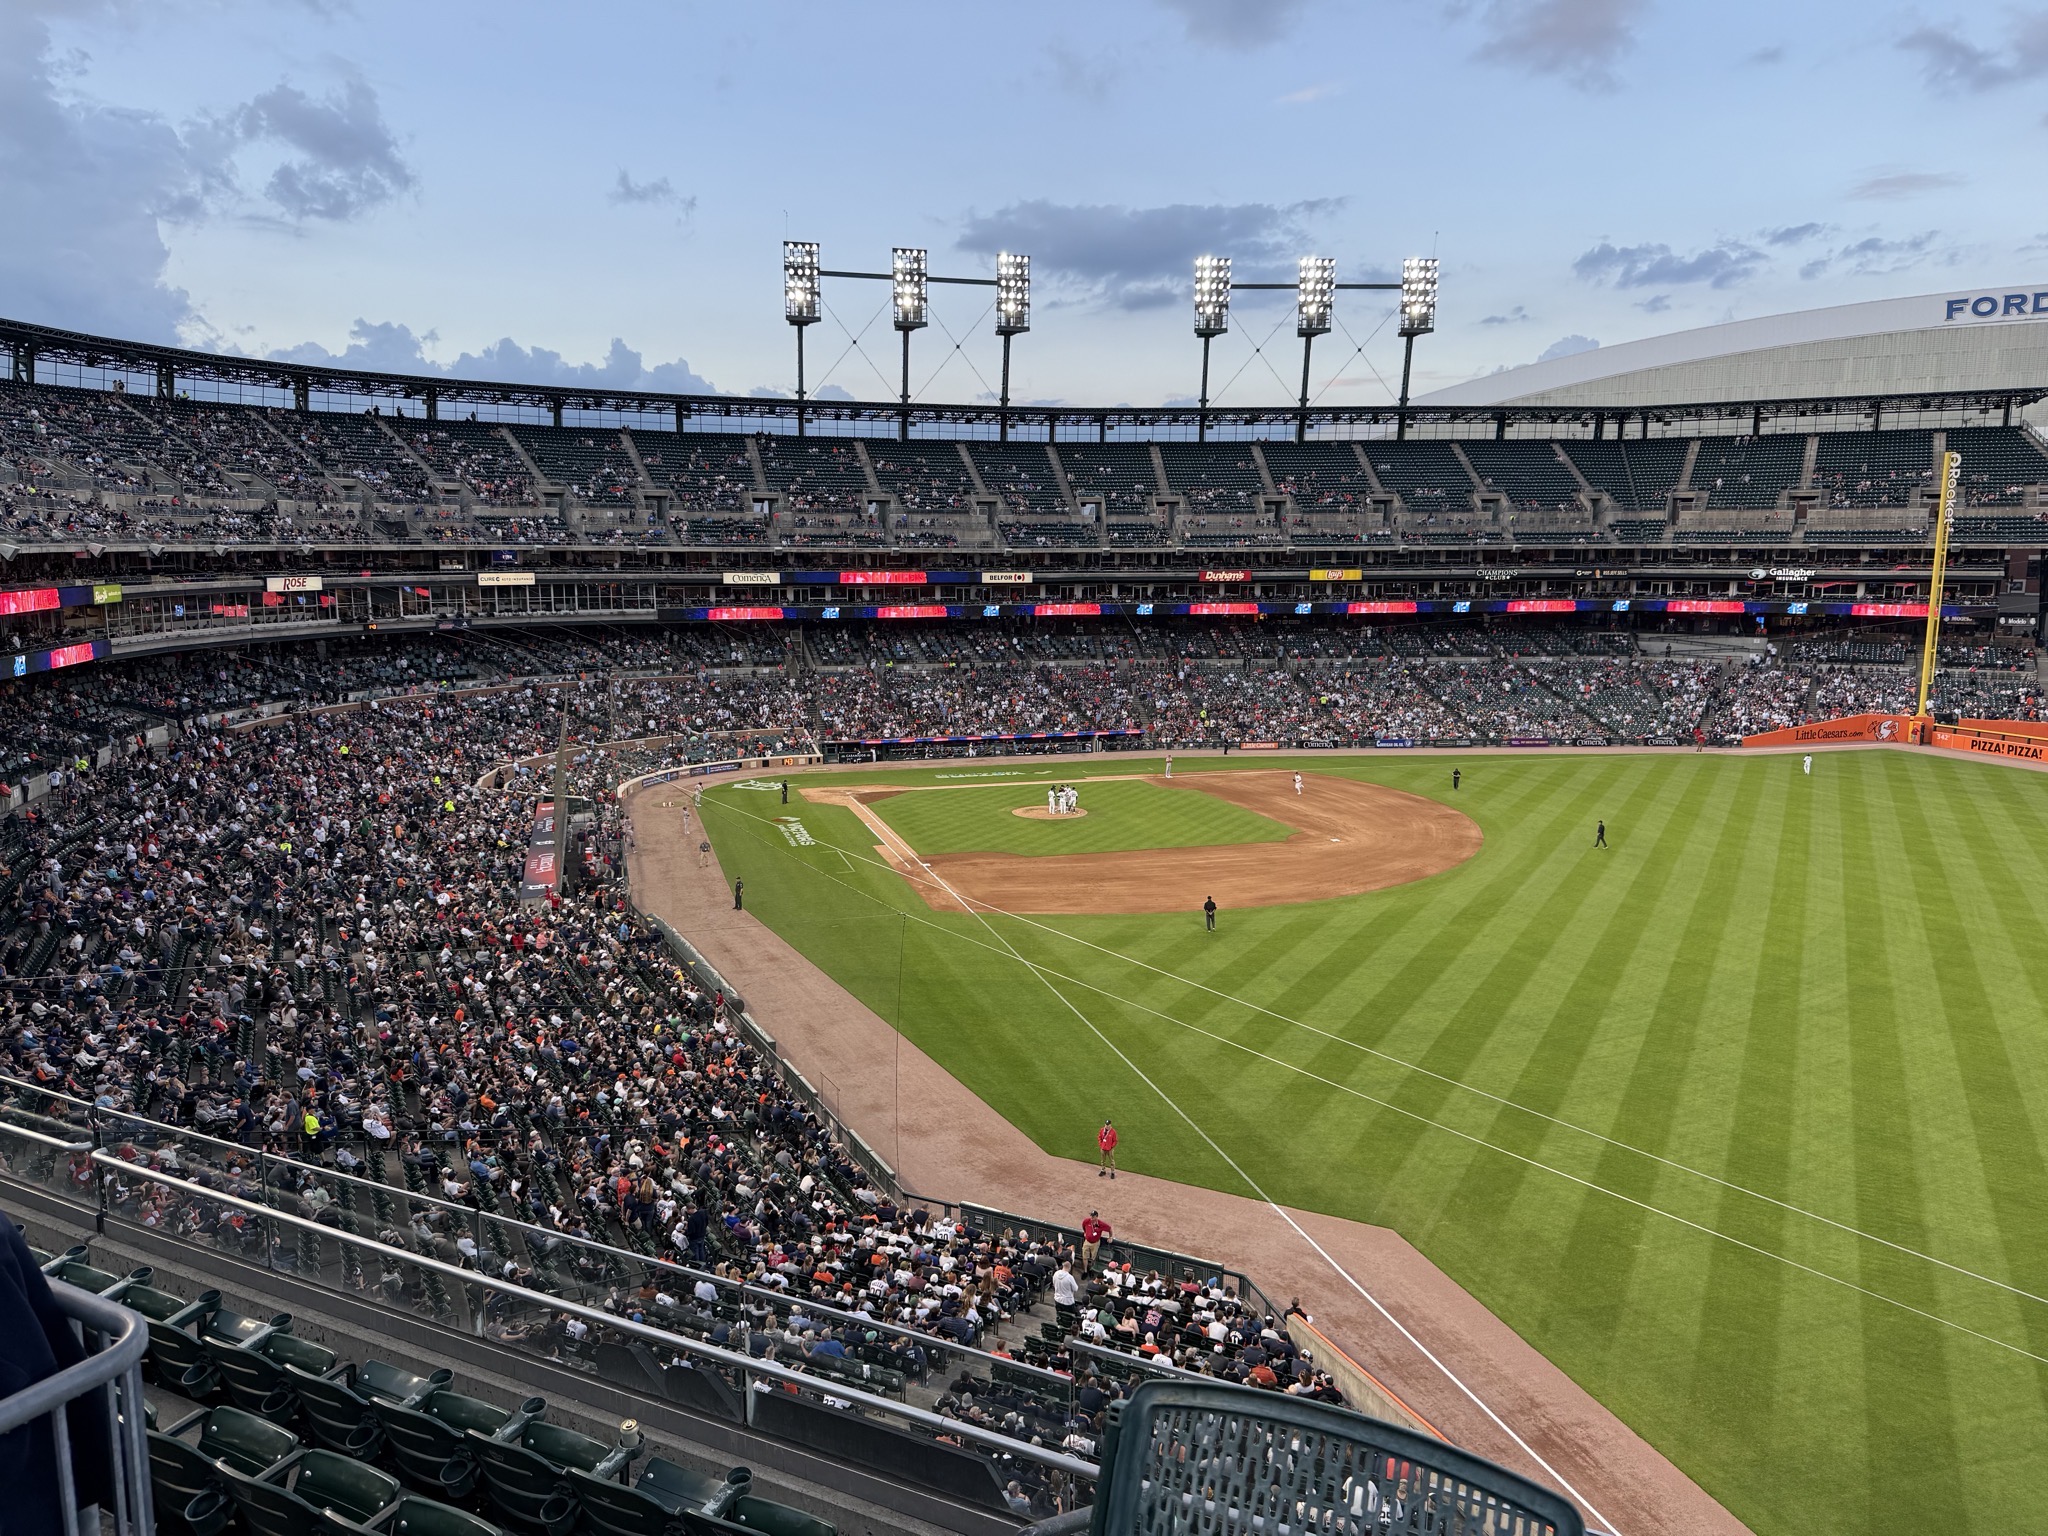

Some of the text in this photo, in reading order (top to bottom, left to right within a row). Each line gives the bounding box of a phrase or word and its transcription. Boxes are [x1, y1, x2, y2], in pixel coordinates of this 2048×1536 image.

[1943, 469, 1961, 525] Rocket
[1205, 571, 1245, 580] Dunham's
[1769, 568, 1817, 577] Gallagher
[283, 577, 307, 591] ROSE
[2008, 617, 2027, 625] Modelo
[1795, 729, 1863, 741] Little Caesars.com
[1971, 739, 2043, 759] PIZZA! PIZZA!
